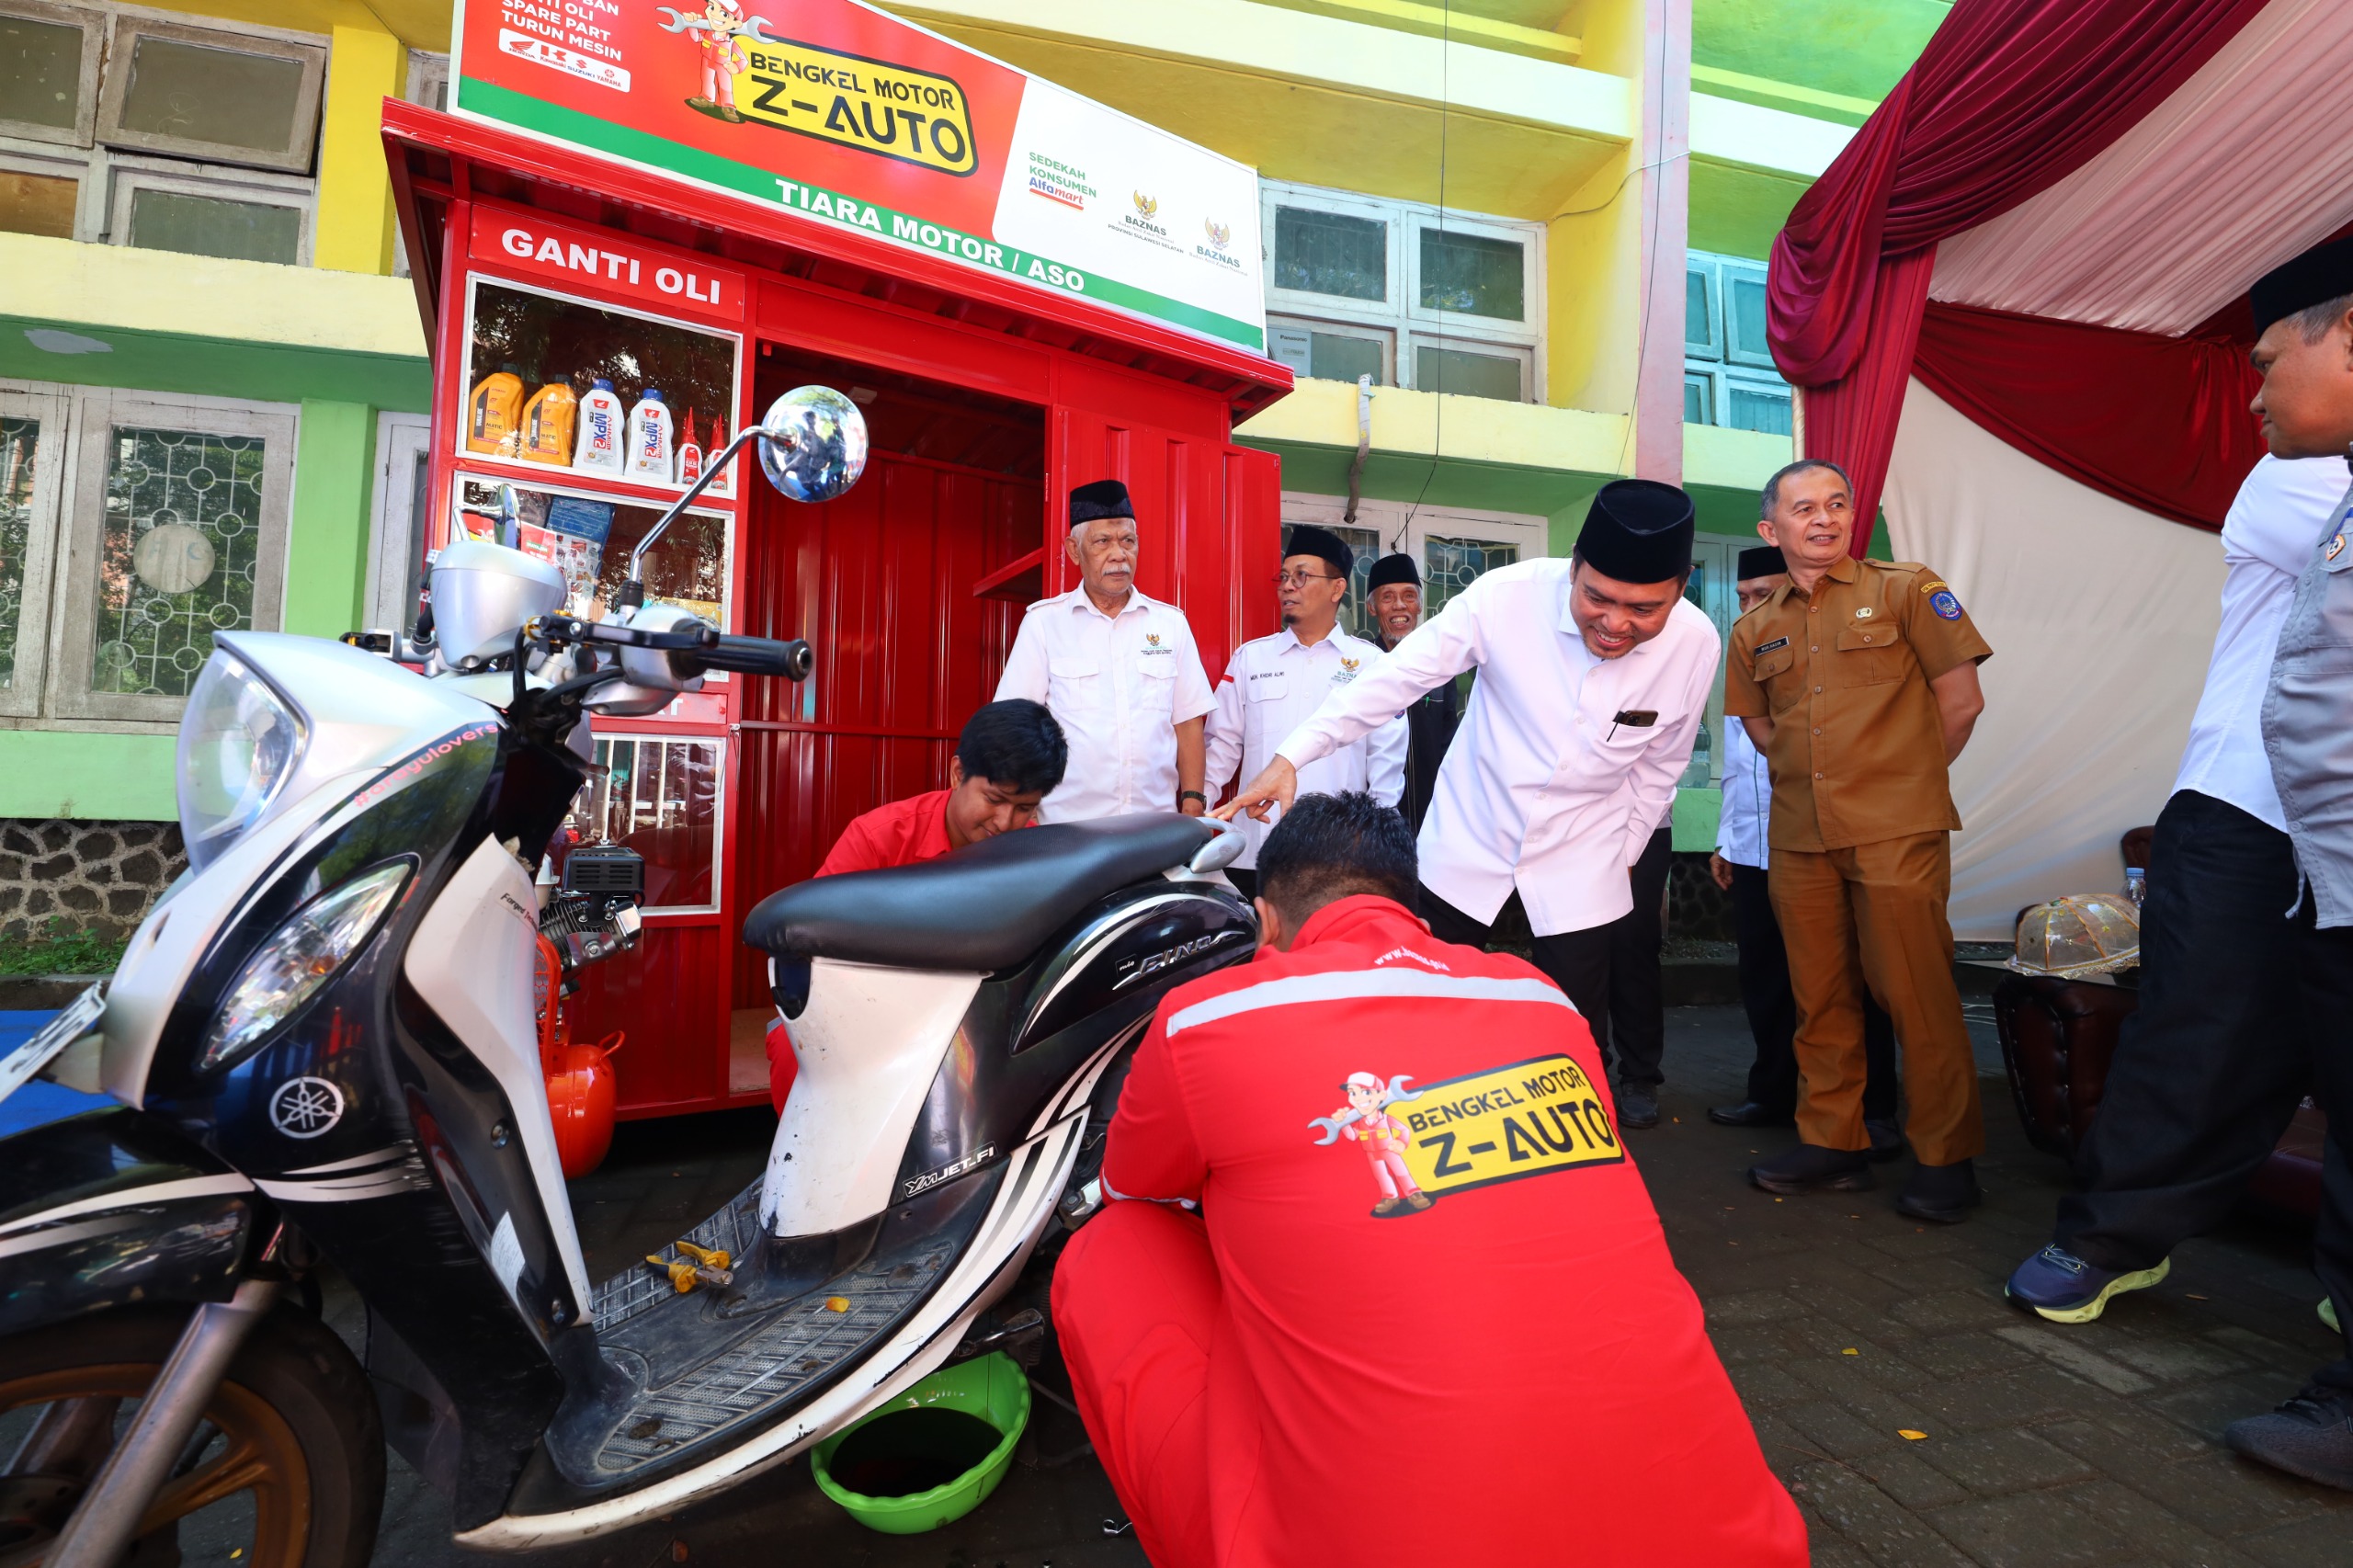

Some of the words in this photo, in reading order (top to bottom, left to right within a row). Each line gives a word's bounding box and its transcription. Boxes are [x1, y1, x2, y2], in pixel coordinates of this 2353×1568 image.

[502, 0, 561, 25] SPARE
[565, 17, 611, 41] PART
[564, 2, 594, 21] OLI
[501, 9, 563, 41] TURUN
[569, 33, 621, 62] MESIN
[567, 65, 596, 78] SUZUKI
[597, 74, 621, 88] YAMAHA
[750, 51, 867, 95] BENGKEL
[874, 76, 955, 111] MOTOR
[751, 75, 967, 165] Z-AUTO
[1029, 152, 1086, 181] SEDEKAH
[1029, 165, 1097, 199] KONSUMEN
[1029, 176, 1084, 205] Alfamart
[776, 178, 882, 231] TIARA
[892, 215, 1004, 268] MOTOR
[1028, 259, 1086, 291] ASO
[1125, 214, 1166, 236] BAZNAS
[1134, 233, 1160, 246] SULAWESI
[1161, 242, 1184, 254] SELATAN
[1197, 244, 1241, 268] BAZNAS
[501, 228, 640, 285] GANTI
[655, 267, 722, 304] OLI
[1279, 335, 1308, 343] Panasonic
[485, 422, 503, 430] MATIC
[593, 412, 608, 449] MPX2
[644, 421, 658, 458] MPX2
[500, 892, 527, 915] Forged
[1408, 1086, 1524, 1133] BENGKEL
[1524, 1065, 1586, 1103] MOTOR
[1419, 1097, 1615, 1178] Z-AUTO
